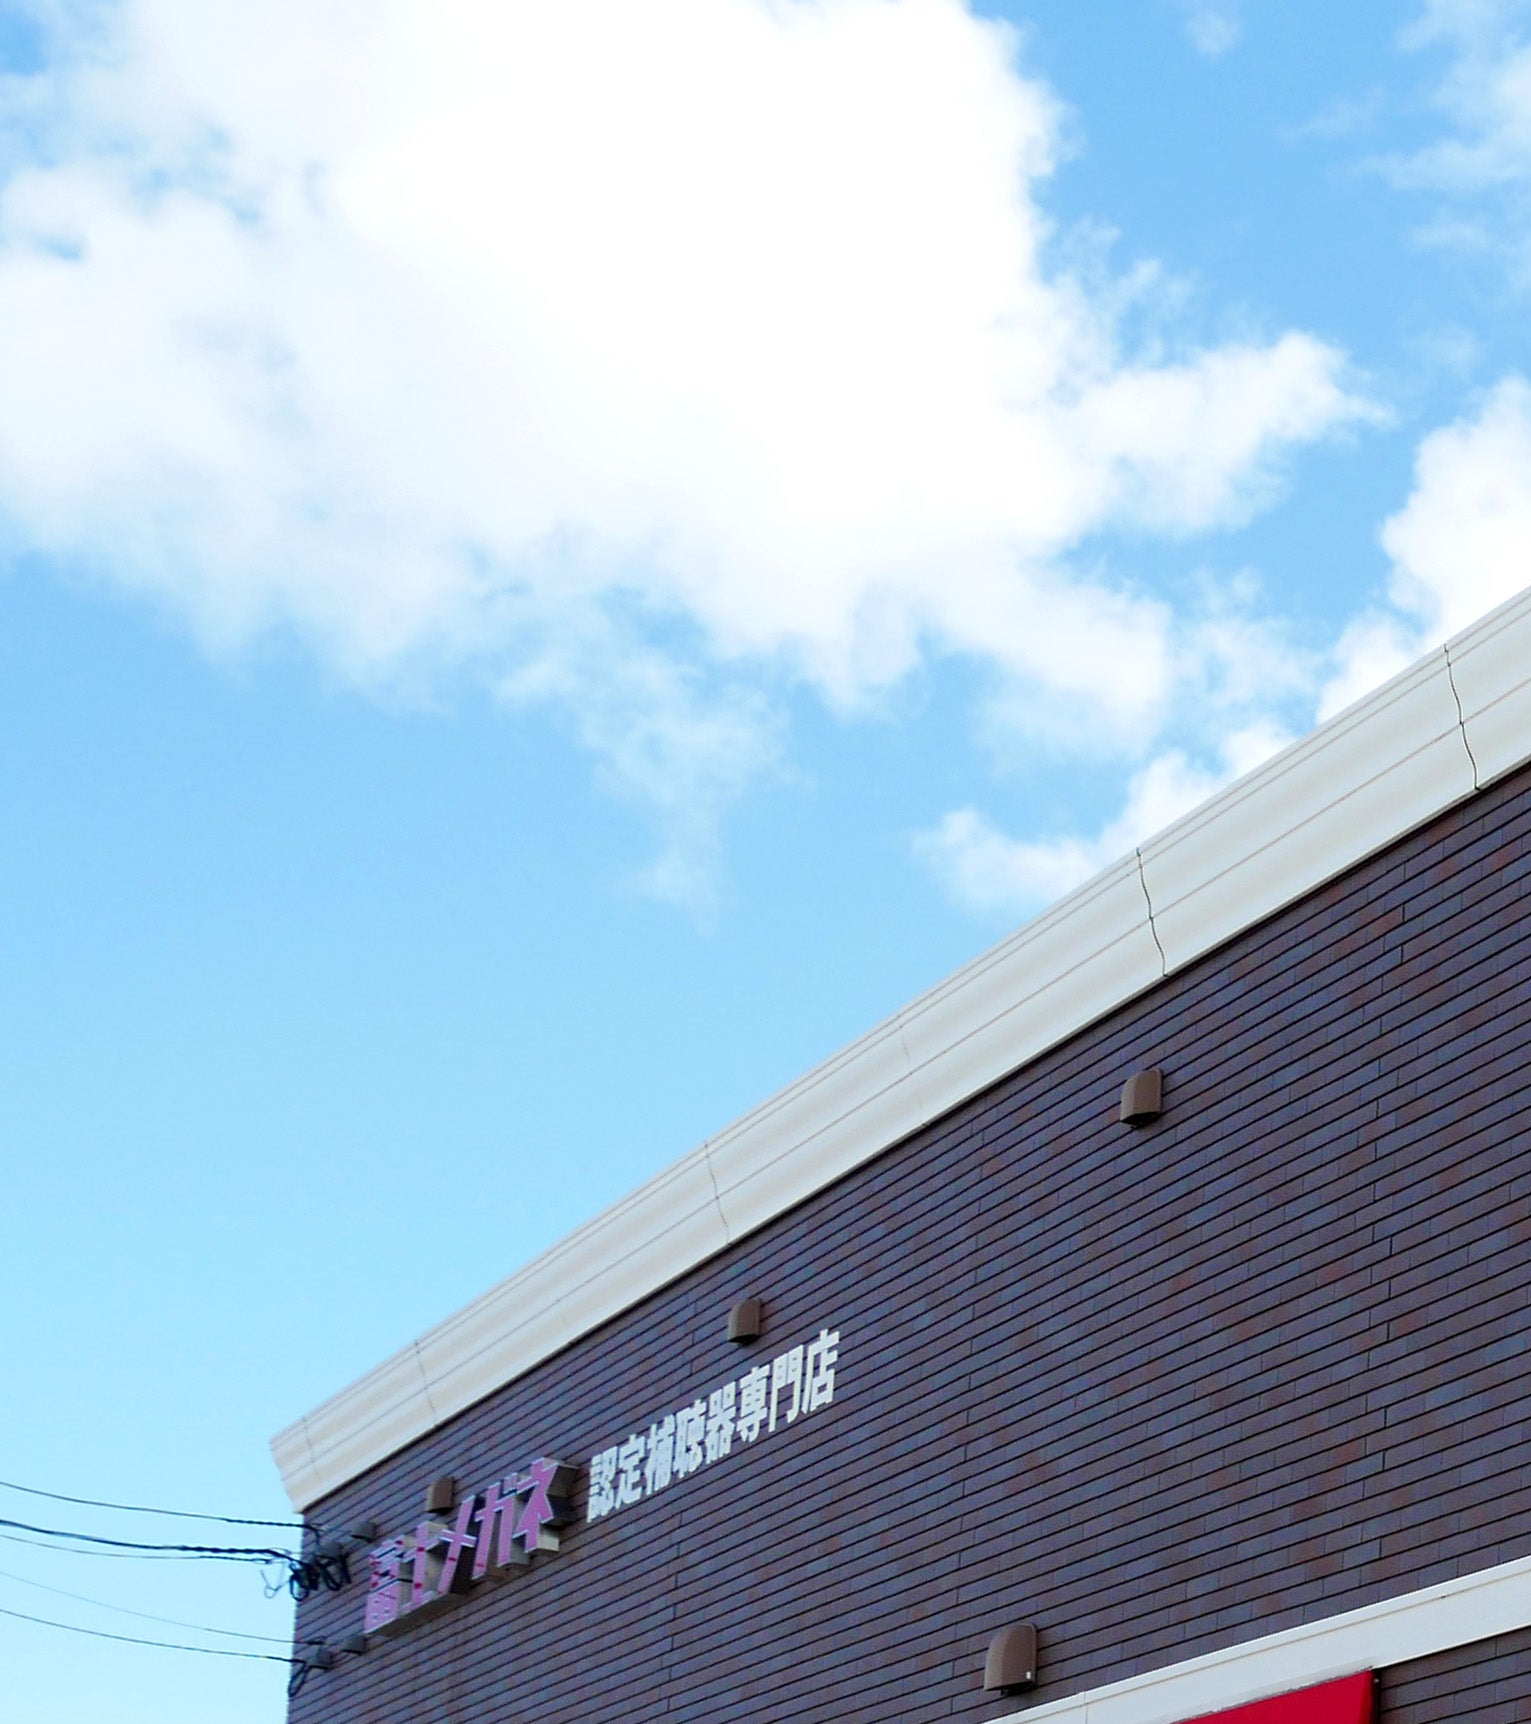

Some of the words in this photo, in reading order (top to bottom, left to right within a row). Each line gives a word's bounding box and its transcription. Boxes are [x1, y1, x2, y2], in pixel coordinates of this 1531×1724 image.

[362, 1456, 562, 1634] 富士メガネ
